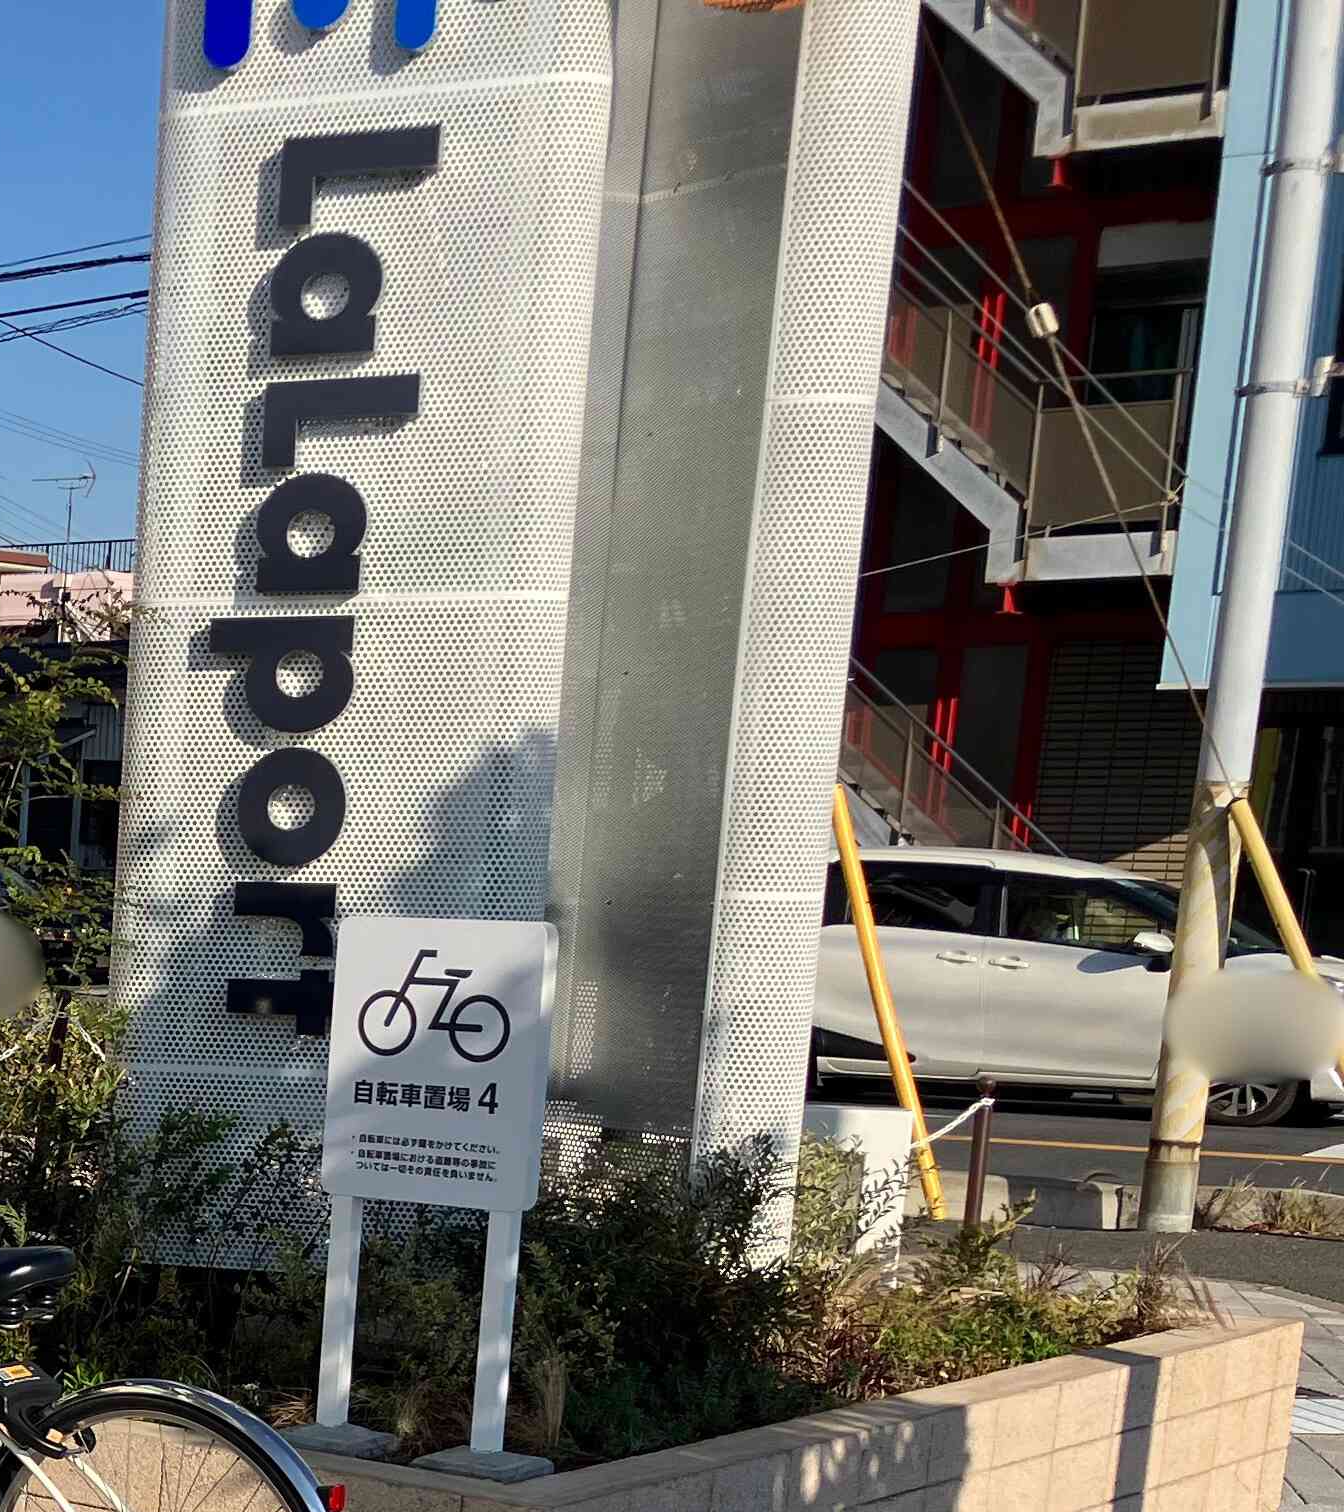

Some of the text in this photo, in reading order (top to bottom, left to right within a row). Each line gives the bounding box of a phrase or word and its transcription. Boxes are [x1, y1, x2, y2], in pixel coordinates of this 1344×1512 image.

[208, 124, 441, 1036] LaLaport
[353, 1080, 499, 1115] 自転車置場 4
